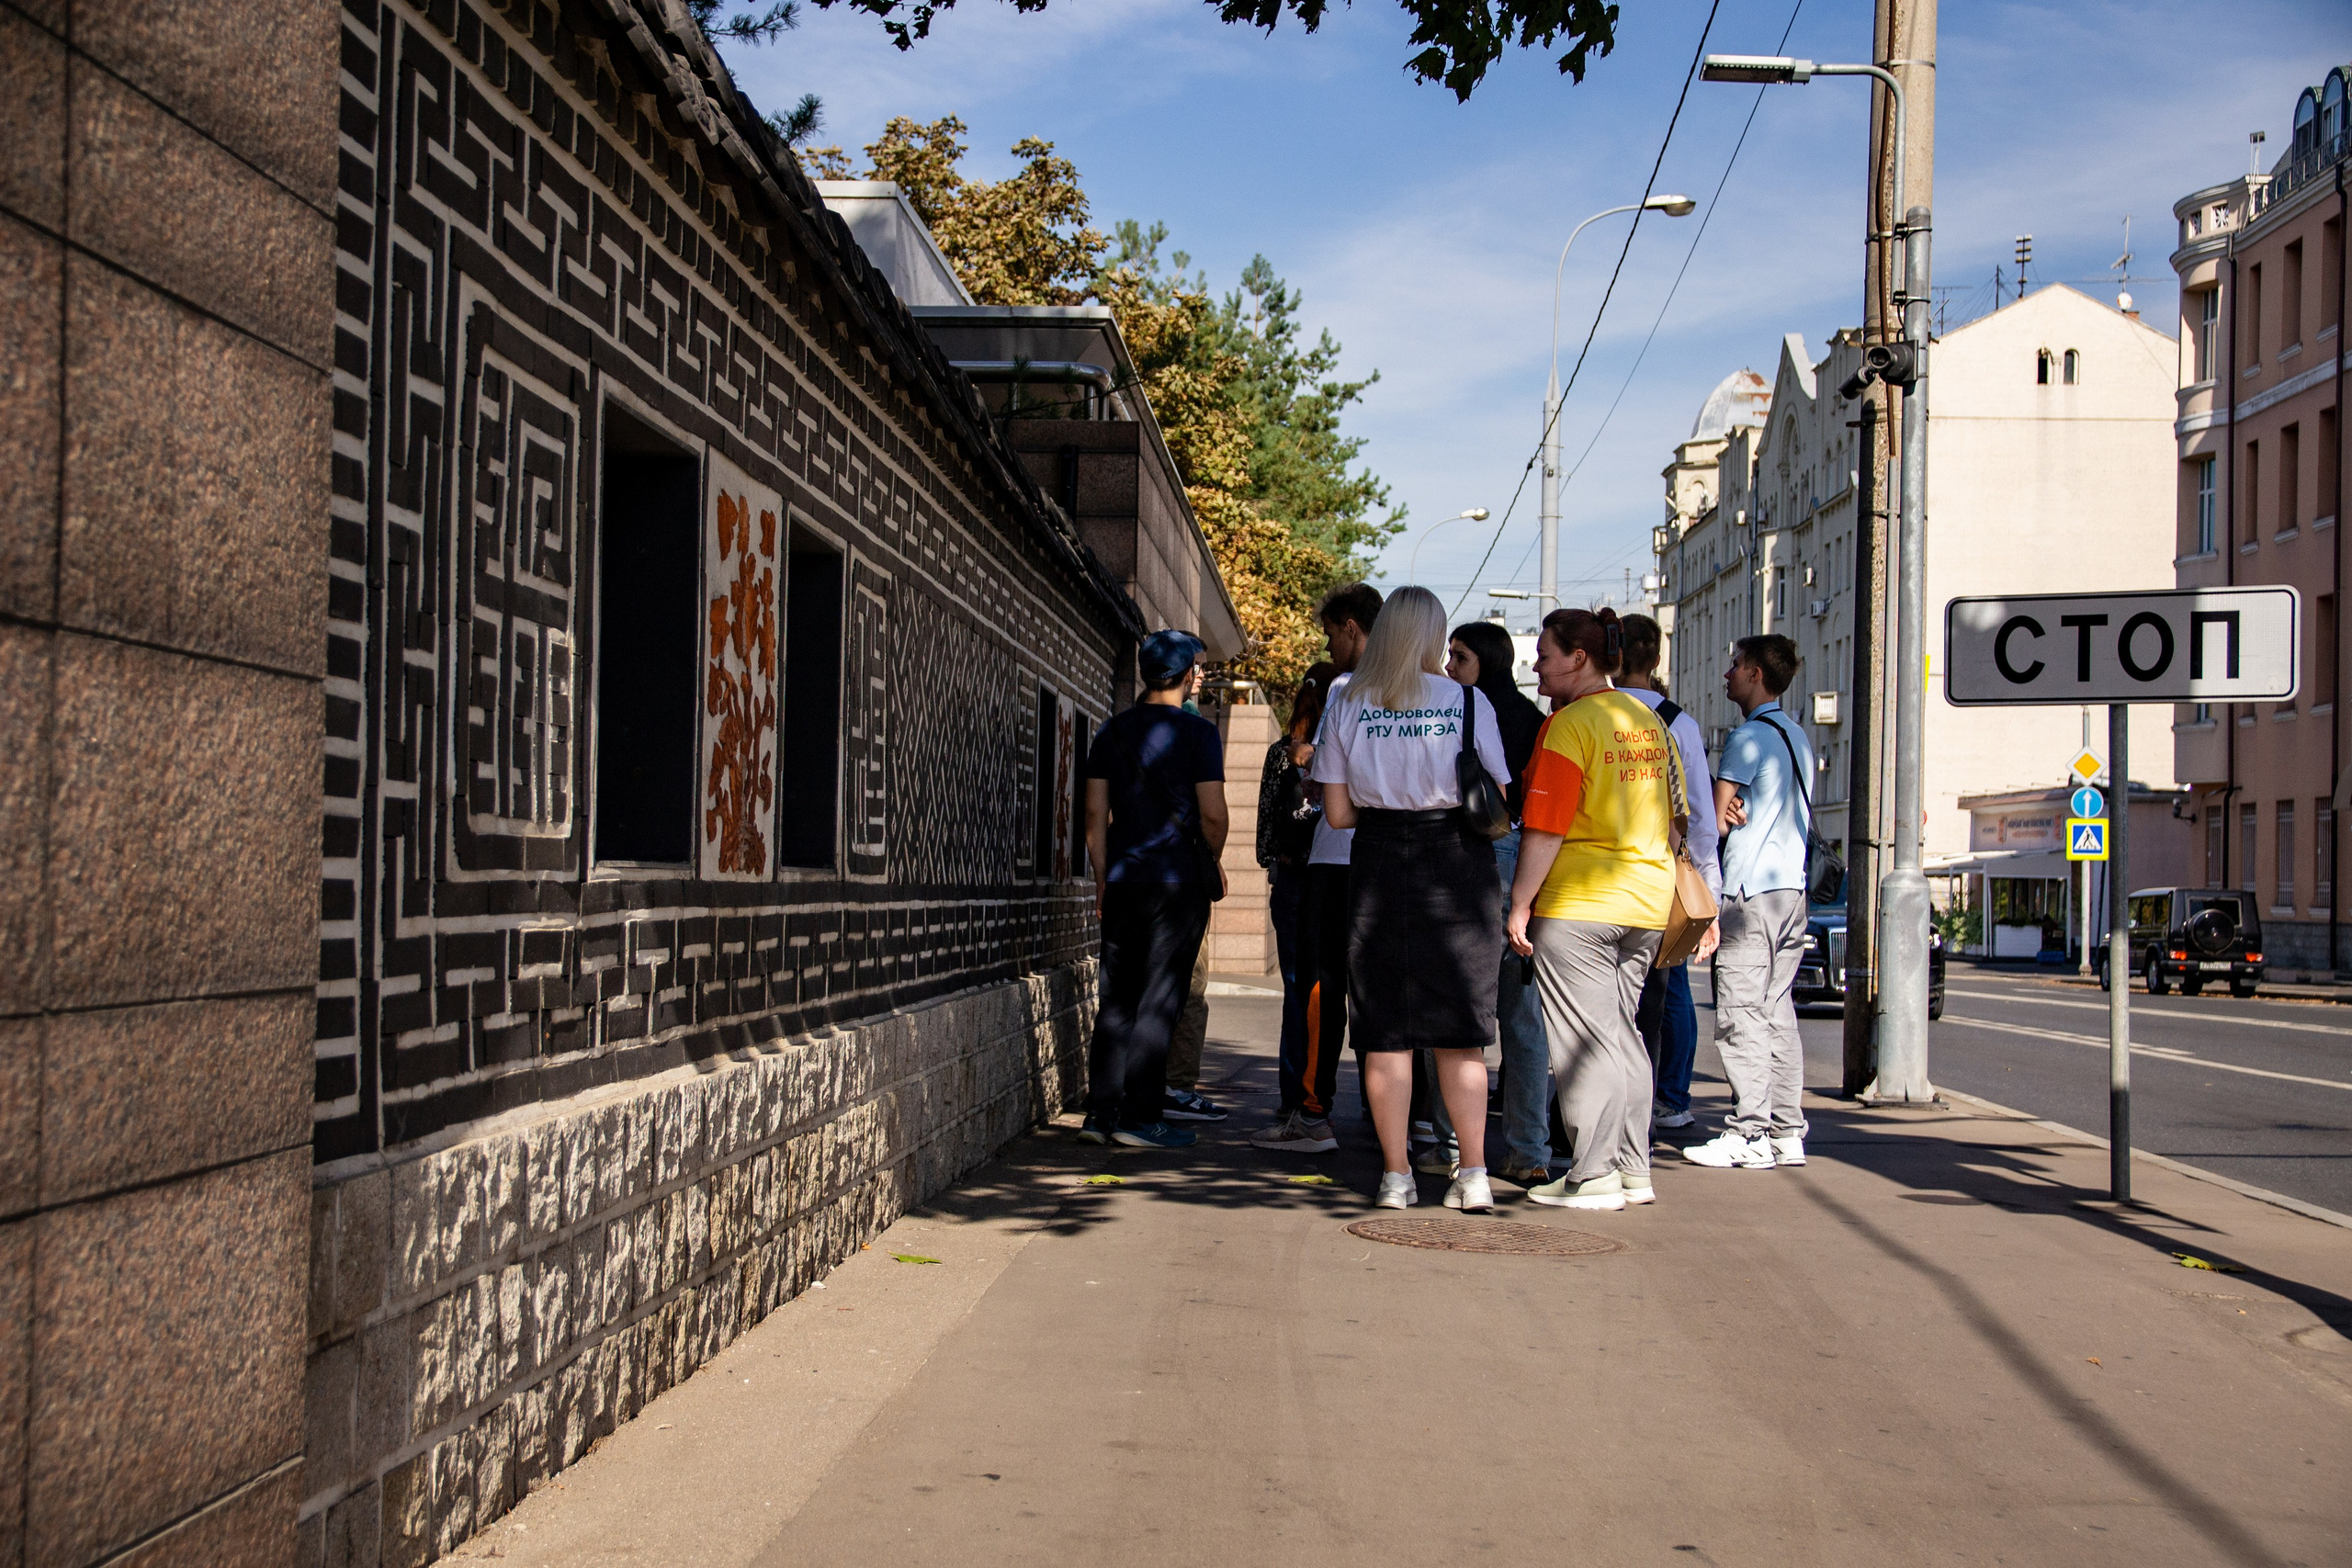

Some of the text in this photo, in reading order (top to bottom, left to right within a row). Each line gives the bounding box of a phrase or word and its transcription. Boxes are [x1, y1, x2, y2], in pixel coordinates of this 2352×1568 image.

[1994, 610, 2240, 683] СТОП
[1359, 707, 1463, 722] Доброволец
[1367, 722, 1457, 739] РТУ МИРЭА
[1614, 729, 1659, 743] СМЫСЛ
[1604, 751, 1614, 764] В
[1620, 767, 1663, 782] ИЗ НАС
